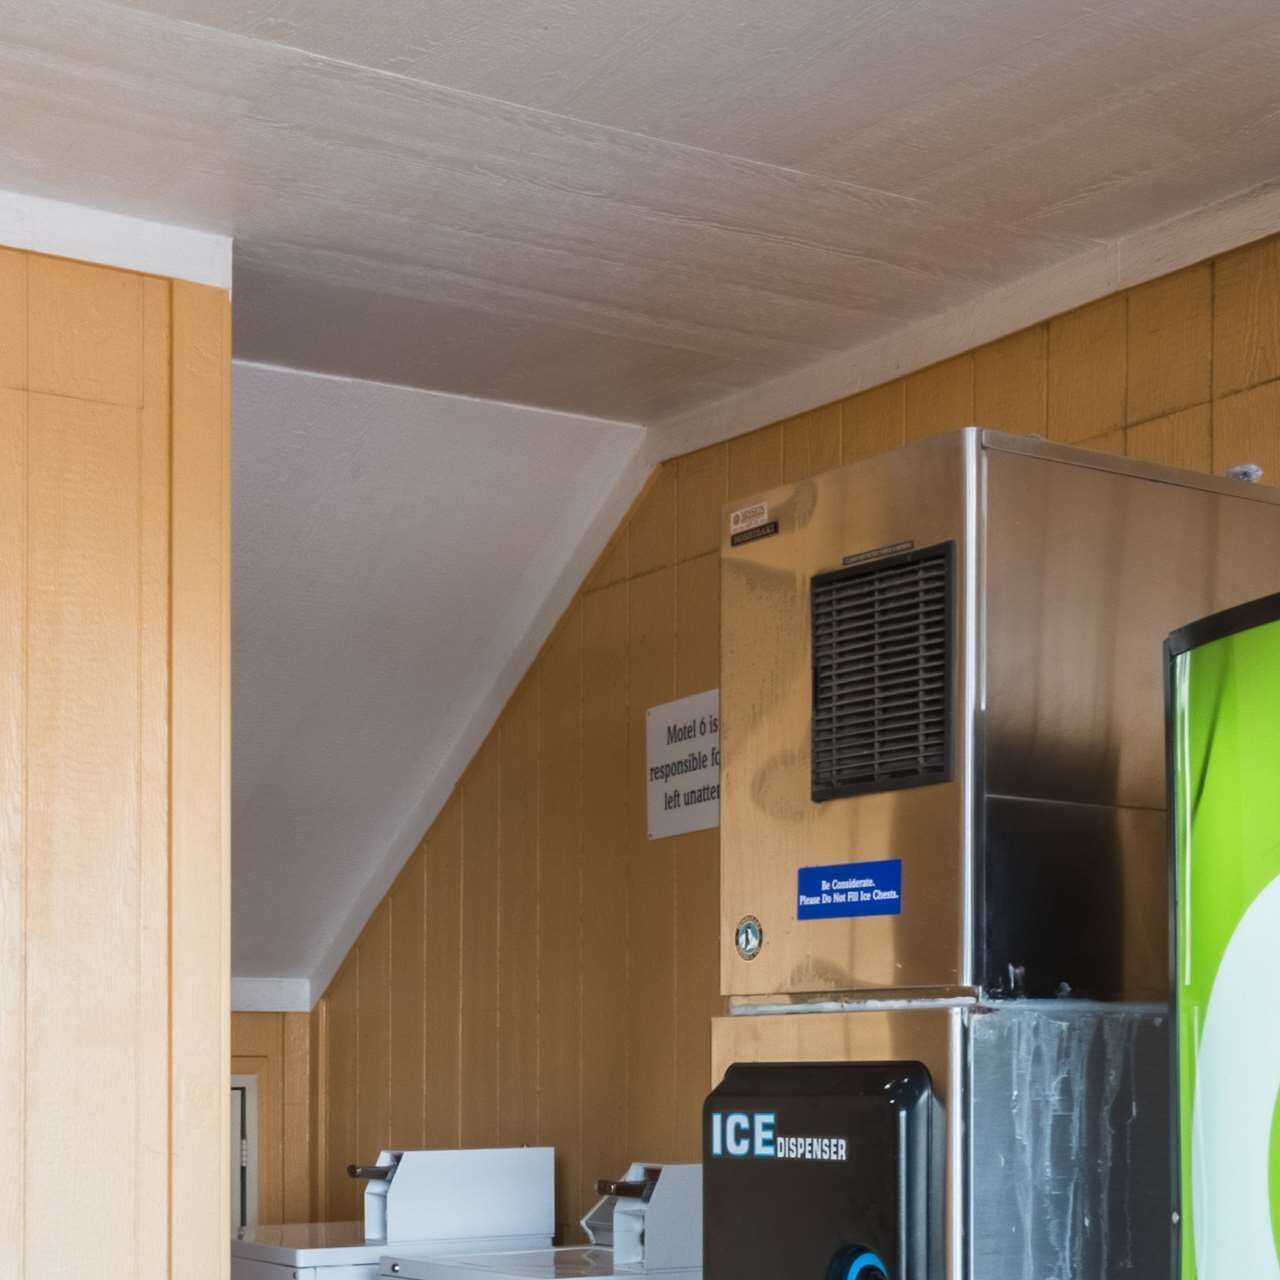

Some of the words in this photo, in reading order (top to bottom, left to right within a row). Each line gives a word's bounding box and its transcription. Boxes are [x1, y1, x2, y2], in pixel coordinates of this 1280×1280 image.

[666, 719, 697, 745] Motel
[700, 718, 707, 737] 6
[709, 715, 719, 734] is
[650, 749, 708, 783] responsible
[664, 789, 681, 811] left
[799, 895, 821, 905] Please
[821, 894, 832, 904] Do
[833, 892, 846, 903] Not
[847, 891, 859, 902] Fill
[860, 890, 871, 901] Ice
[872, 889, 899, 900] Chests.
[821, 880, 830, 890] Be
[832, 878, 876, 890] Considerate.
[712, 1113, 775, 1155] ICE
[776, 1136, 846, 1161] DISPENSER
